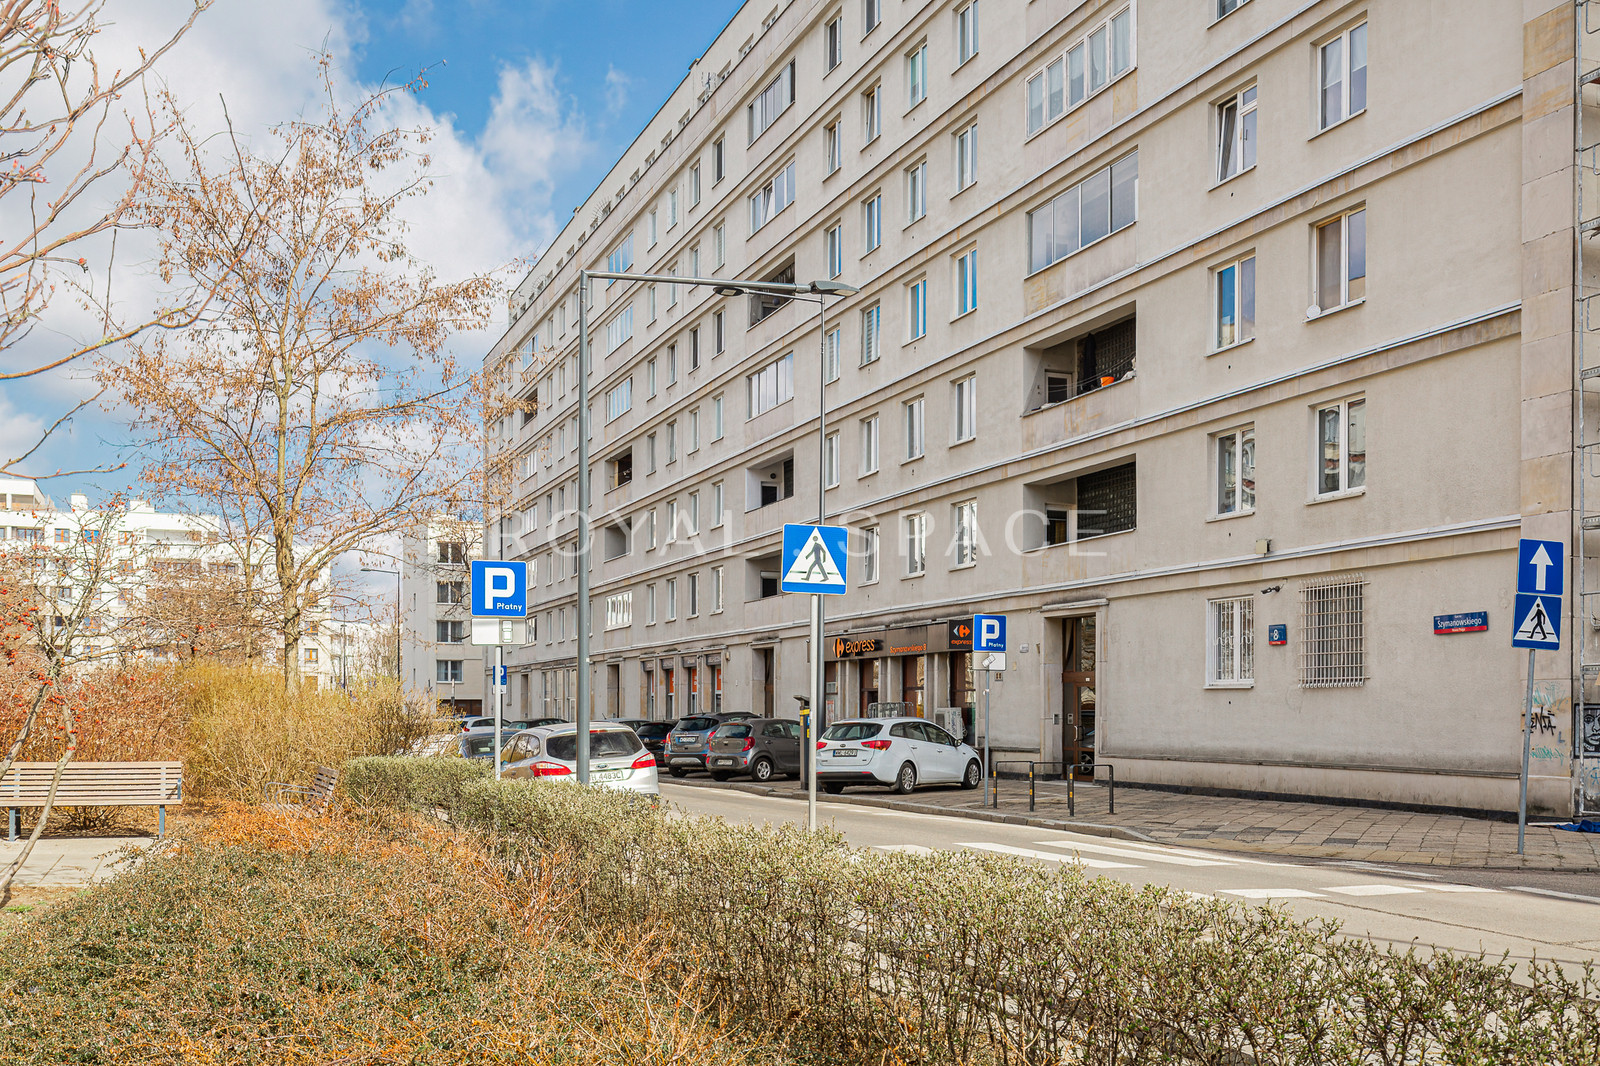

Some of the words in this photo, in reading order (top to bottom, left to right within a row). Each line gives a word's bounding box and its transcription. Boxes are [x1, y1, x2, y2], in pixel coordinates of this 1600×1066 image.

[484, 567, 516, 609] P
[496, 602, 523, 612] Płatny
[1437, 616, 1482, 629] Szymanowskiego
[981, 619, 1000, 647] P
[1273, 629, 1279, 640] 8
[845, 639, 875, 656] express
